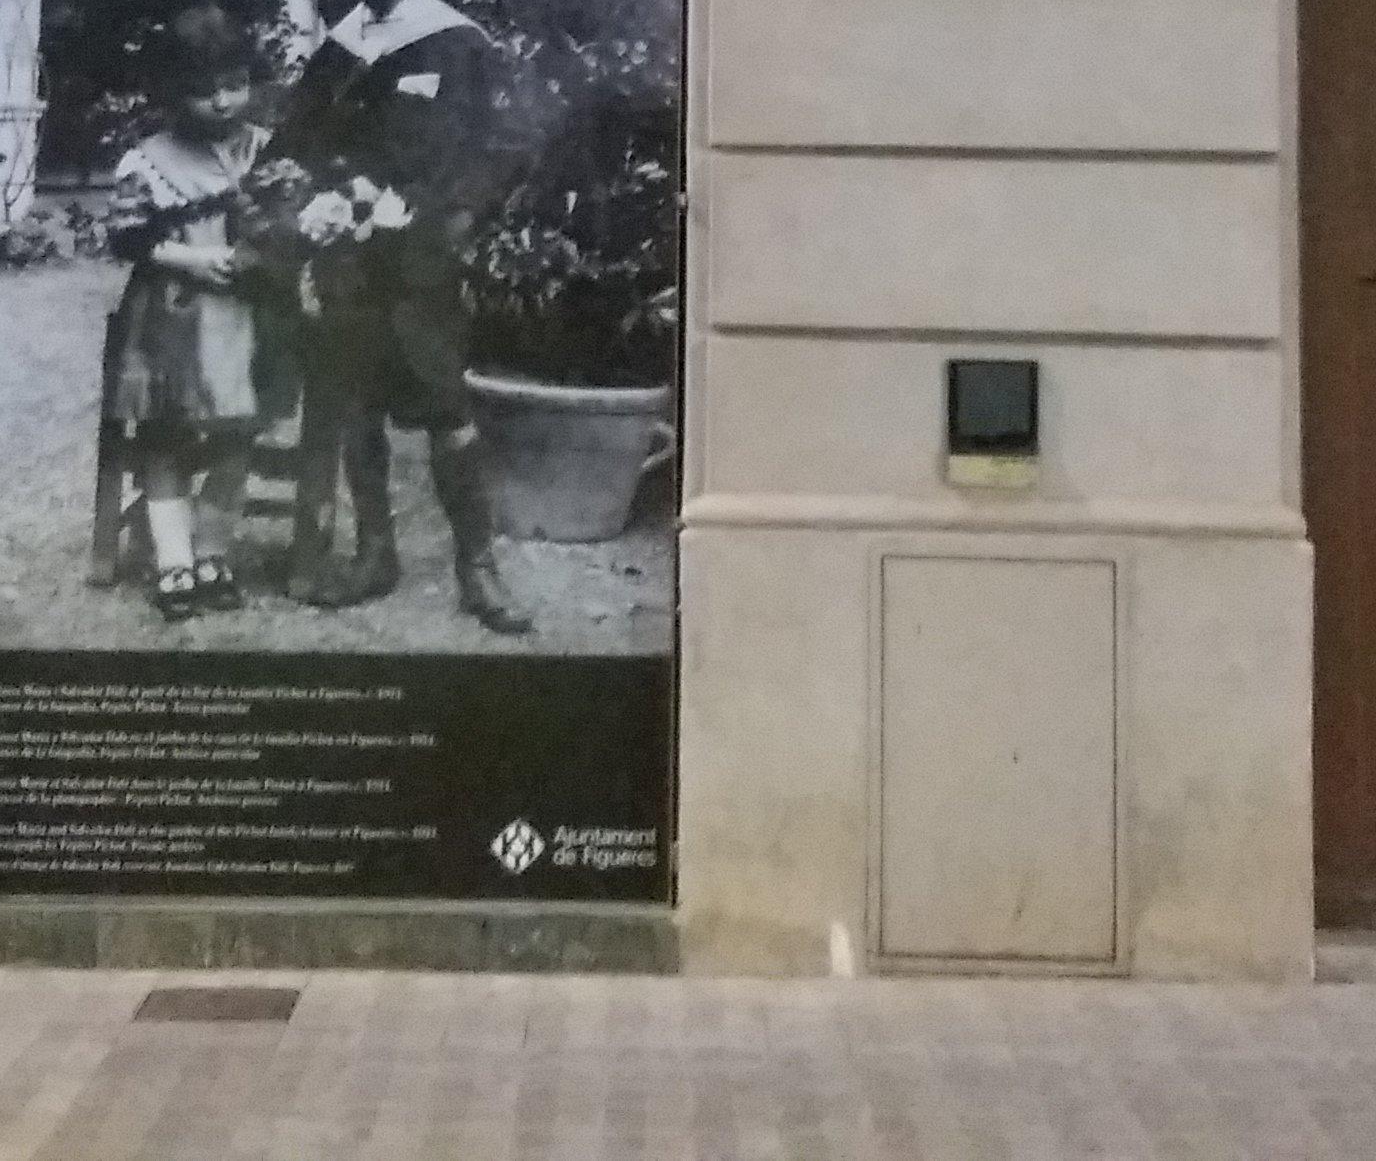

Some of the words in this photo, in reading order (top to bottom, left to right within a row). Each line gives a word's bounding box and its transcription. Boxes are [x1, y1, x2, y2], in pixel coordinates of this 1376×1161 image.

[553, 826, 657, 849] Ajuntament
[552, 847, 575, 866] de
[582, 846, 657, 870] Figueres
